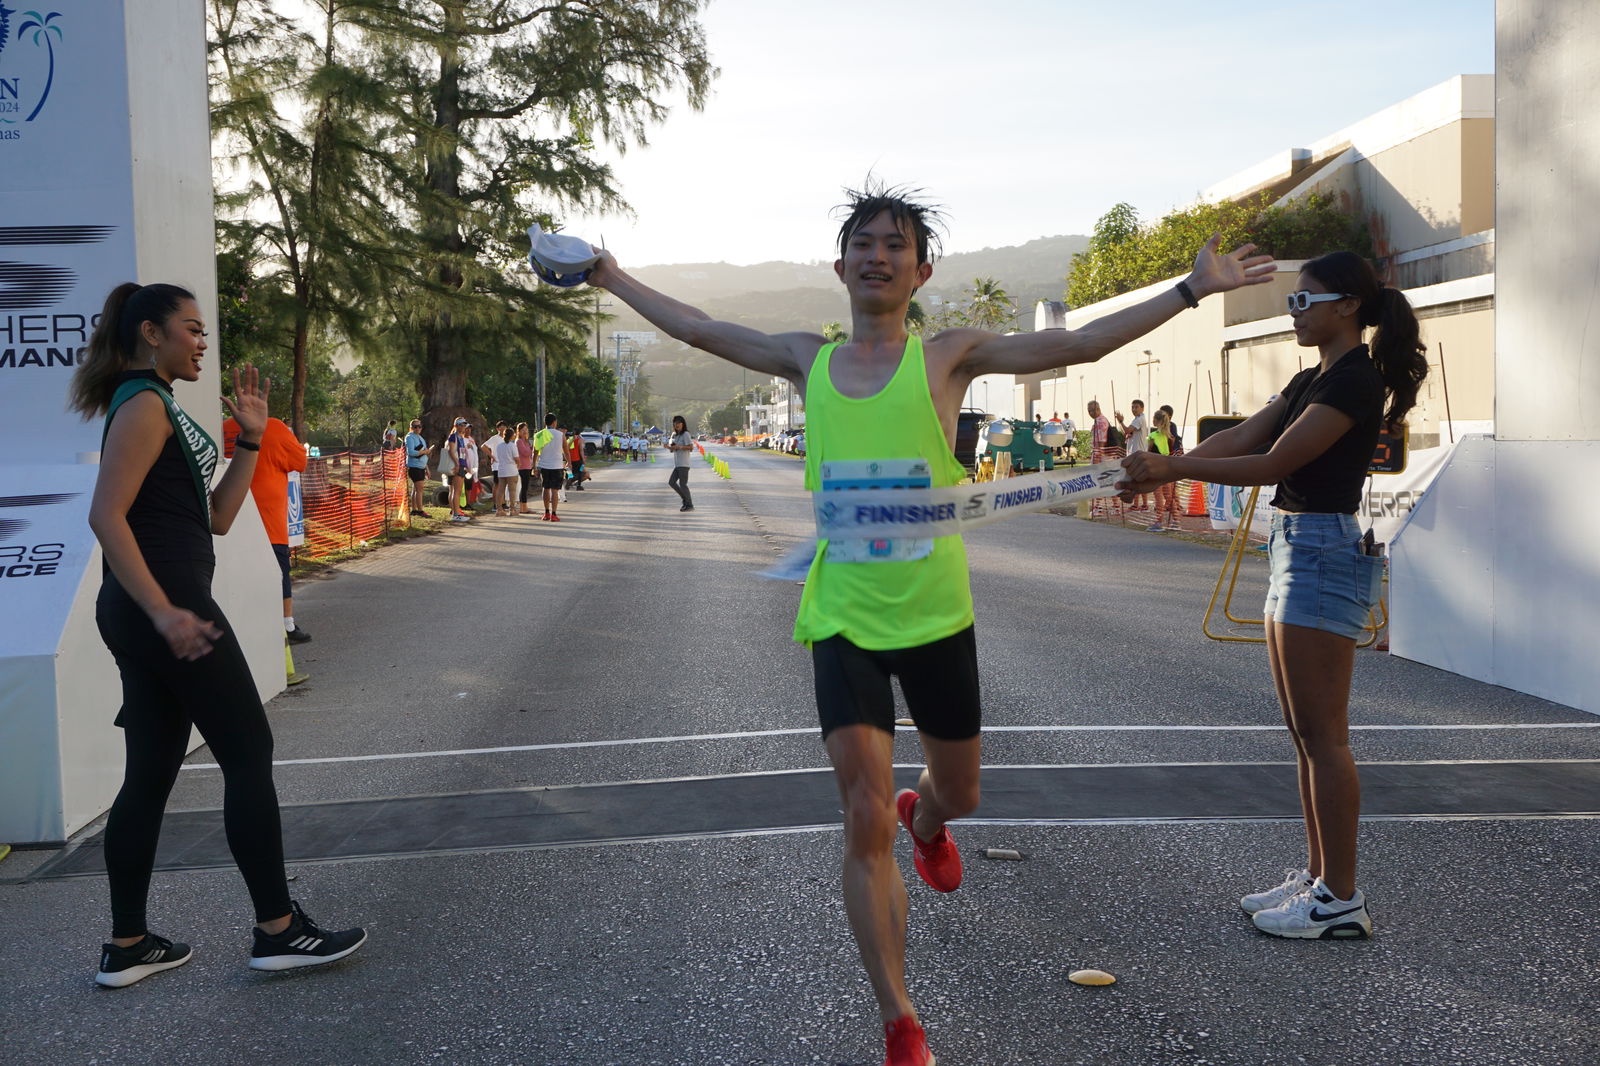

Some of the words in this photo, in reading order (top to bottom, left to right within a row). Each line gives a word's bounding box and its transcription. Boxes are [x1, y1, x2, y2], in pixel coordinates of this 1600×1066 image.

[855, 502, 956, 524] FINISHER
[994, 485, 1043, 511] FINISHER
[1059, 474, 1097, 496] FINISHER
[0, 562, 59, 578] CE
